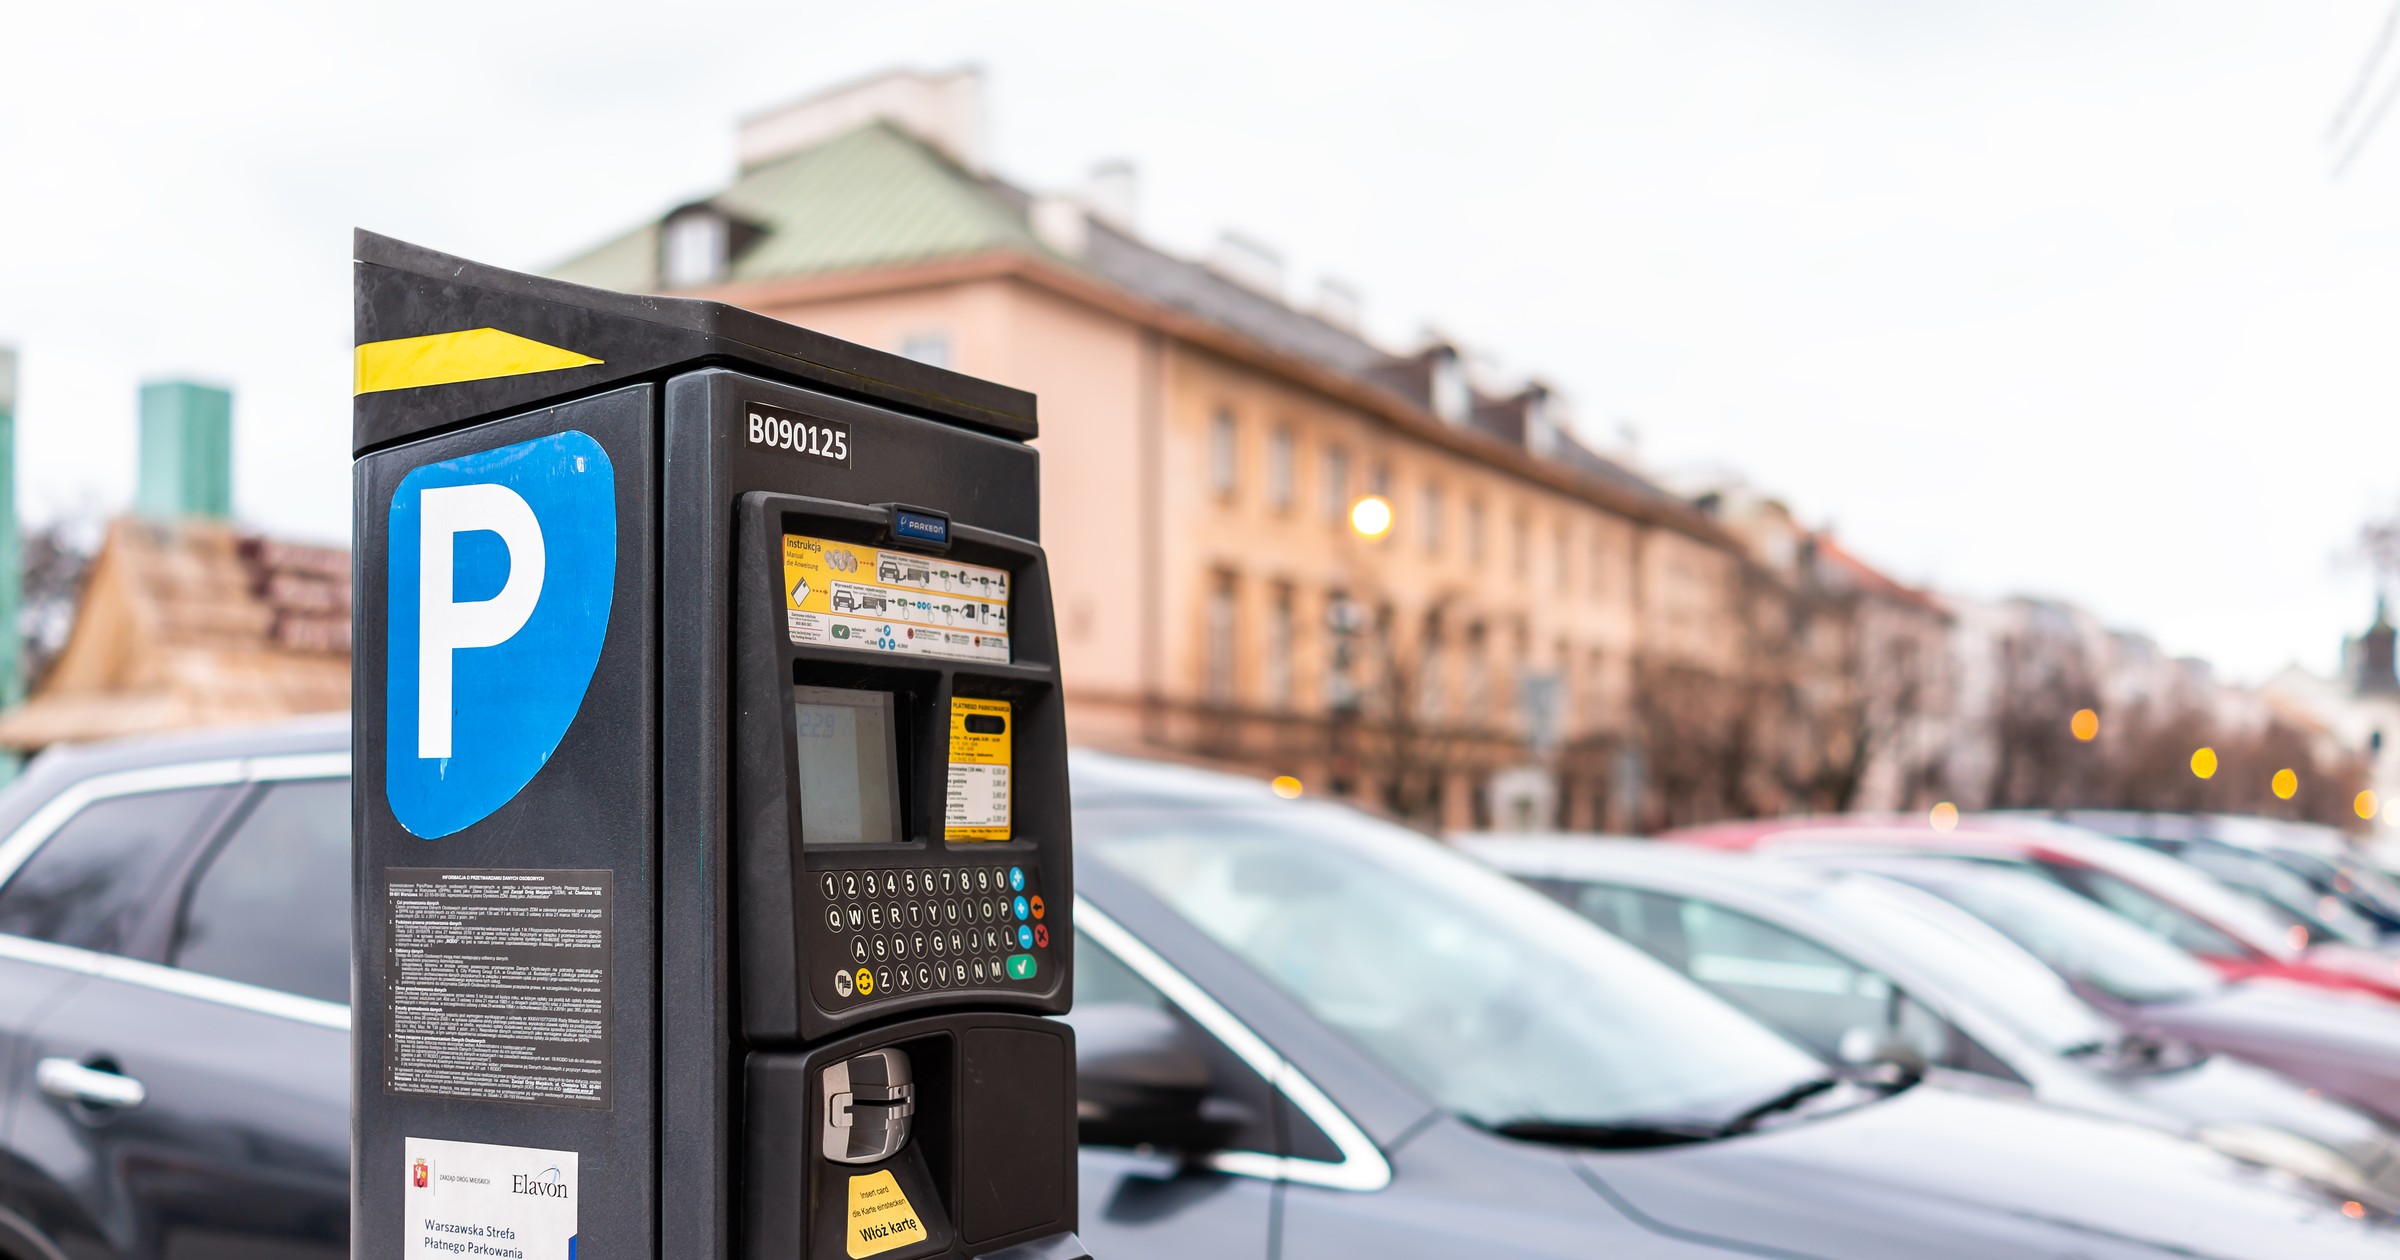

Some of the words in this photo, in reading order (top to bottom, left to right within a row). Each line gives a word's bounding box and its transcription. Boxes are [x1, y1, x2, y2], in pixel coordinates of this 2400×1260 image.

[750, 413, 847, 460] B090125
[908, 521, 944, 534] PARKEON
[787, 538, 821, 553] Instrukcja
[787, 551, 804, 559] Manual
[794, 561, 818, 571] Anweisung
[418, 483, 546, 759] P
[826, 877, 834, 895] 1
[846, 876, 856, 894] 2
[867, 876, 876, 893] 3
[887, 875, 896, 892] 4
[906, 874, 914, 892] 5
[925, 874, 933, 891] 6
[942, 874, 950, 890] 7
[961, 873, 969, 890] 8
[979, 872, 986, 889] 9
[996, 872, 1004, 888] 0
[830, 911, 841, 927] Q
[848, 910, 861, 925] W
[871, 909, 880, 924] E
[891, 908, 900, 922] R
[910, 907, 918, 921] T
[929, 906, 936, 920] Y
[948, 905, 956, 919] U
[968, 904, 972, 918] I
[983, 903, 992, 917] O
[1000, 902, 1008, 916] P
[856, 942, 866, 957] A
[876, 940, 884, 956] S
[896, 939, 904, 954] D
[916, 938, 922, 952] F
[934, 936, 943, 951] G
[952, 935, 961, 949] H
[972, 934, 977, 948] J
[988, 932, 996, 946] K
[1005, 932, 1013, 945] L
[881, 972, 890, 987] Z
[900, 970, 910, 986] X
[920, 968, 928, 983] C
[938, 967, 946, 981] V
[956, 966, 965, 980] B
[974, 964, 983, 978] N
[991, 962, 1001, 976] M
[512, 1174, 568, 1198] Elavon
[860, 1189, 876, 1199] Insert
[876, 1186, 890, 1195] card
[852, 1210, 861, 1218] die
[861, 1206, 877, 1215] Karte
[877, 1198, 906, 1211] einstecken
[424, 1219, 484, 1236] Warszawska
[486, 1226, 515, 1240] Strefa
[859, 1224, 889, 1242] Włóż
[888, 1218, 917, 1234] kartę
[424, 1237, 465, 1254] Płatnego
[468, 1242, 522, 1259] Parkowania
